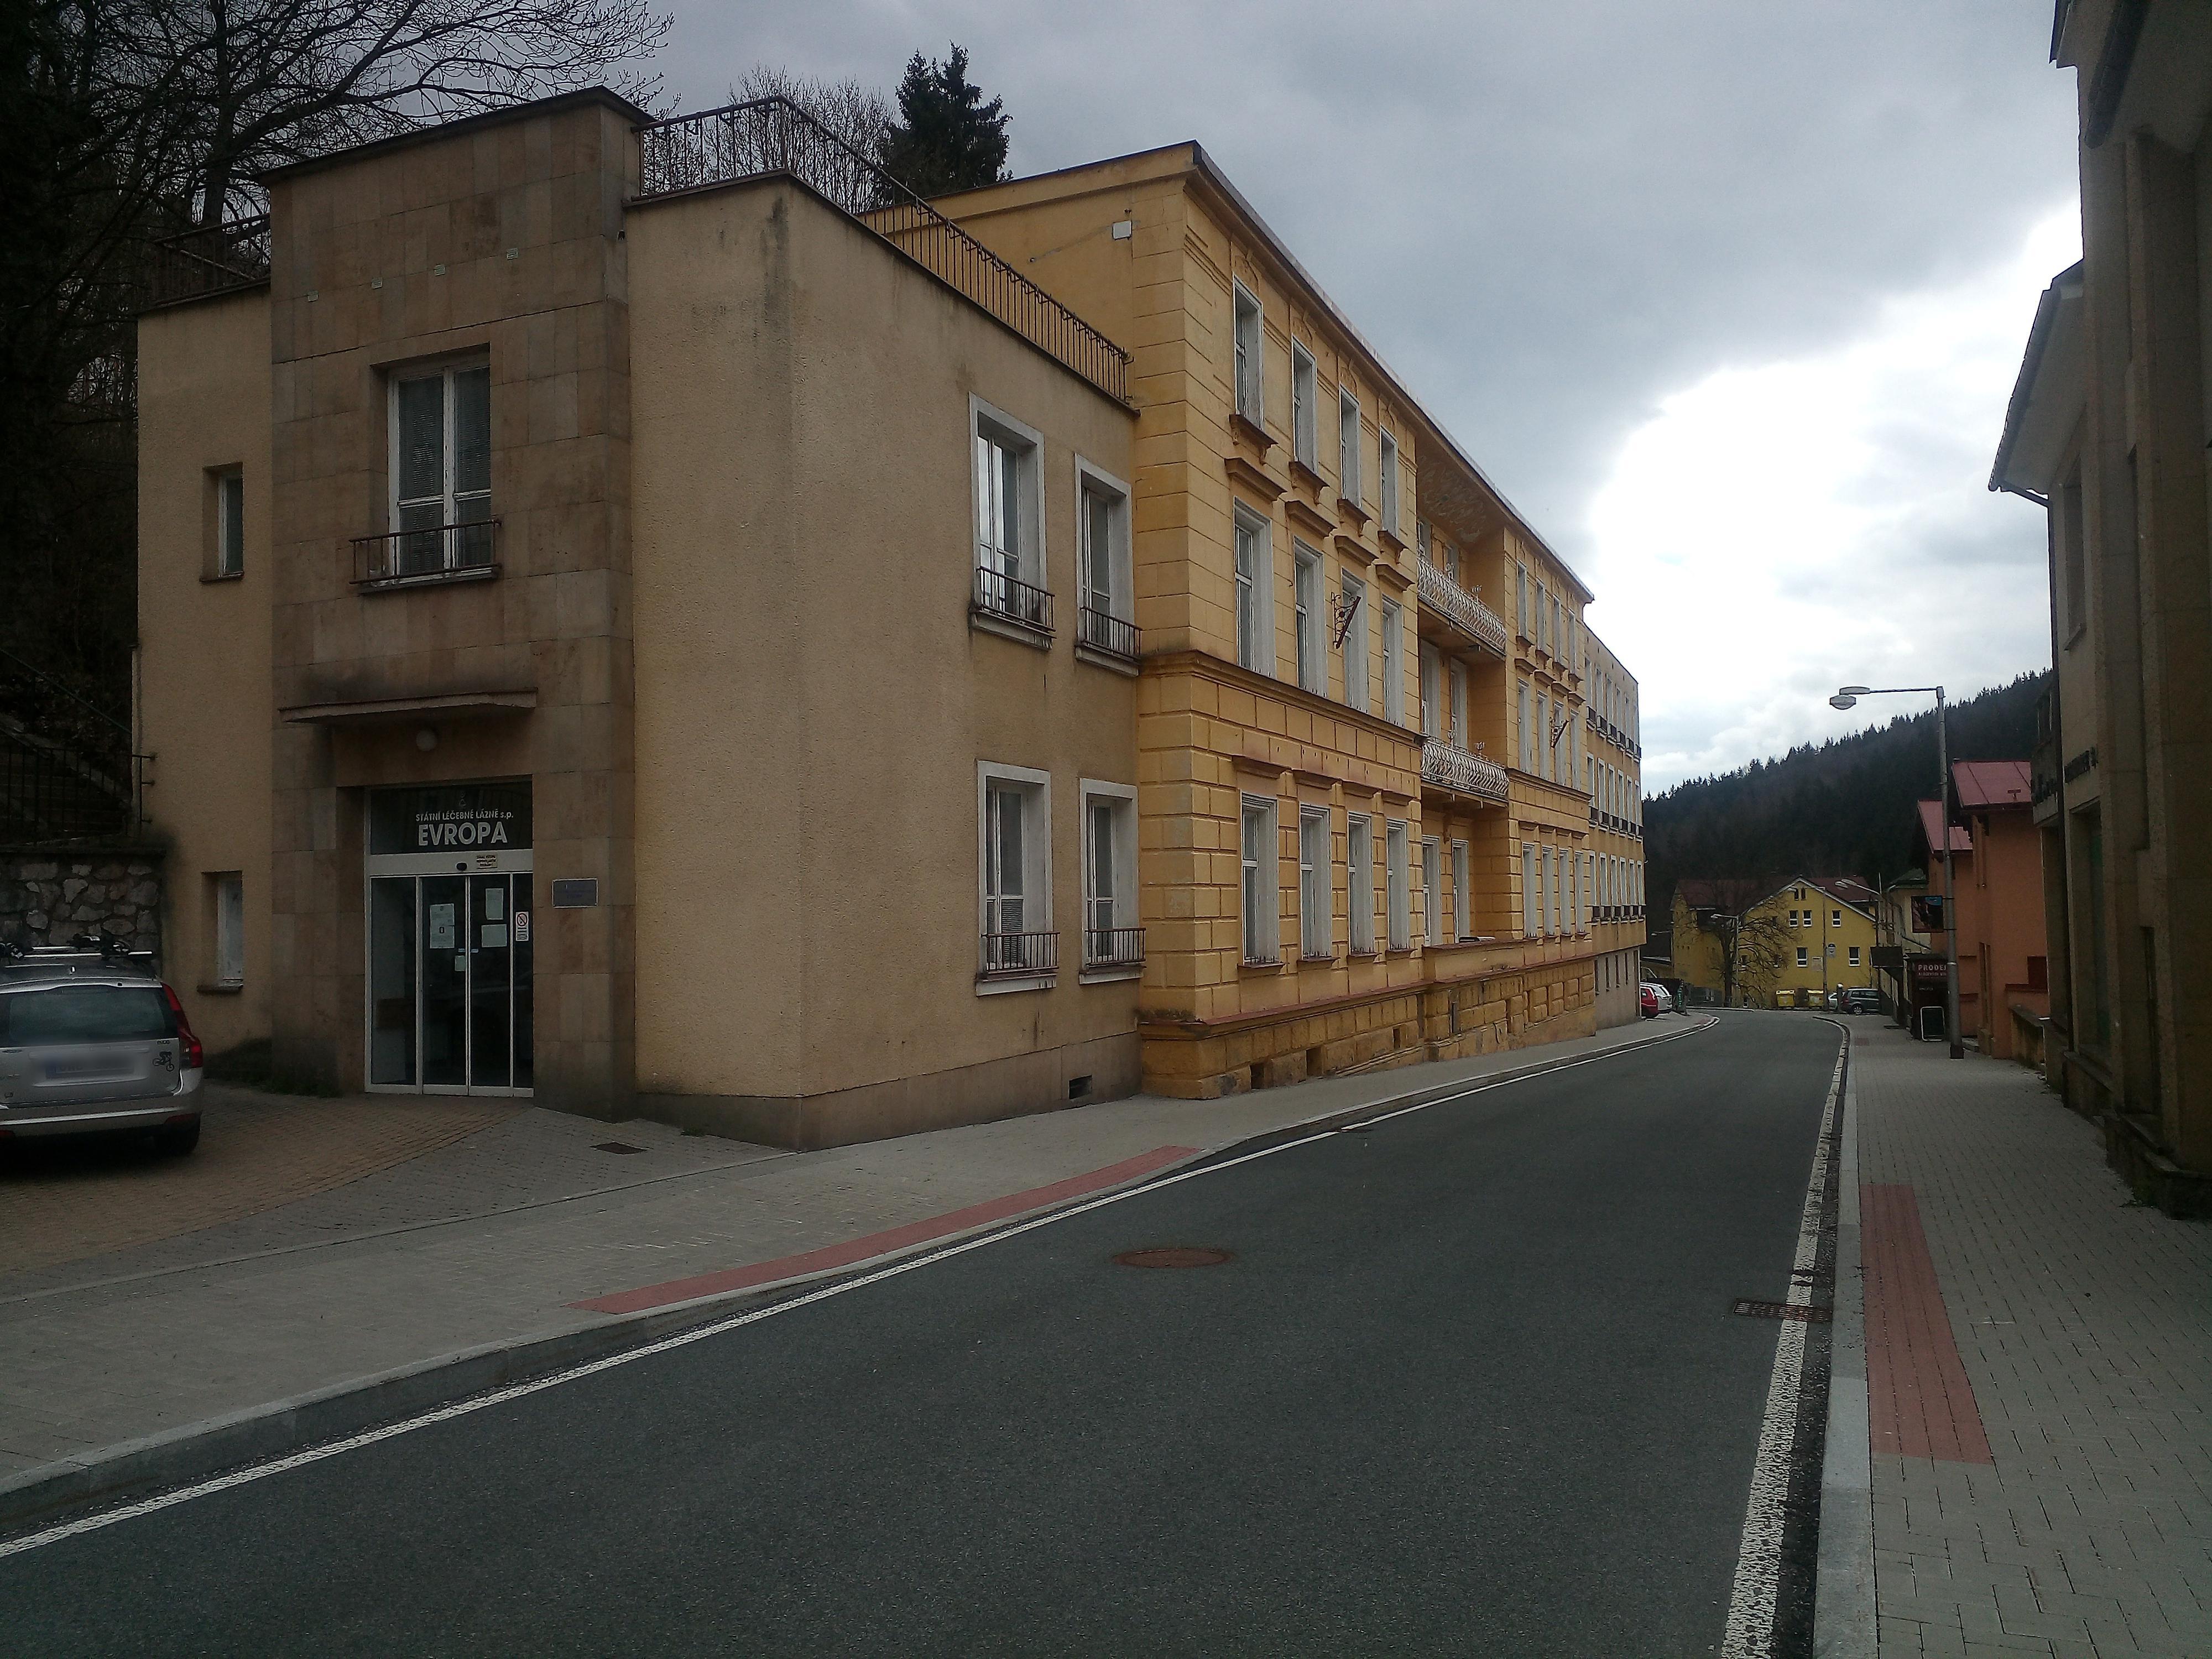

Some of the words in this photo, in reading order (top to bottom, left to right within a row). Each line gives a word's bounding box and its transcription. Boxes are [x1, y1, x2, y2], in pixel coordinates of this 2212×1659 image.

[416, 811, 441, 822] STÁTNÍ
[442, 809, 474, 820] LÉČEBNÉ
[419, 821, 508, 846] EVROPA
